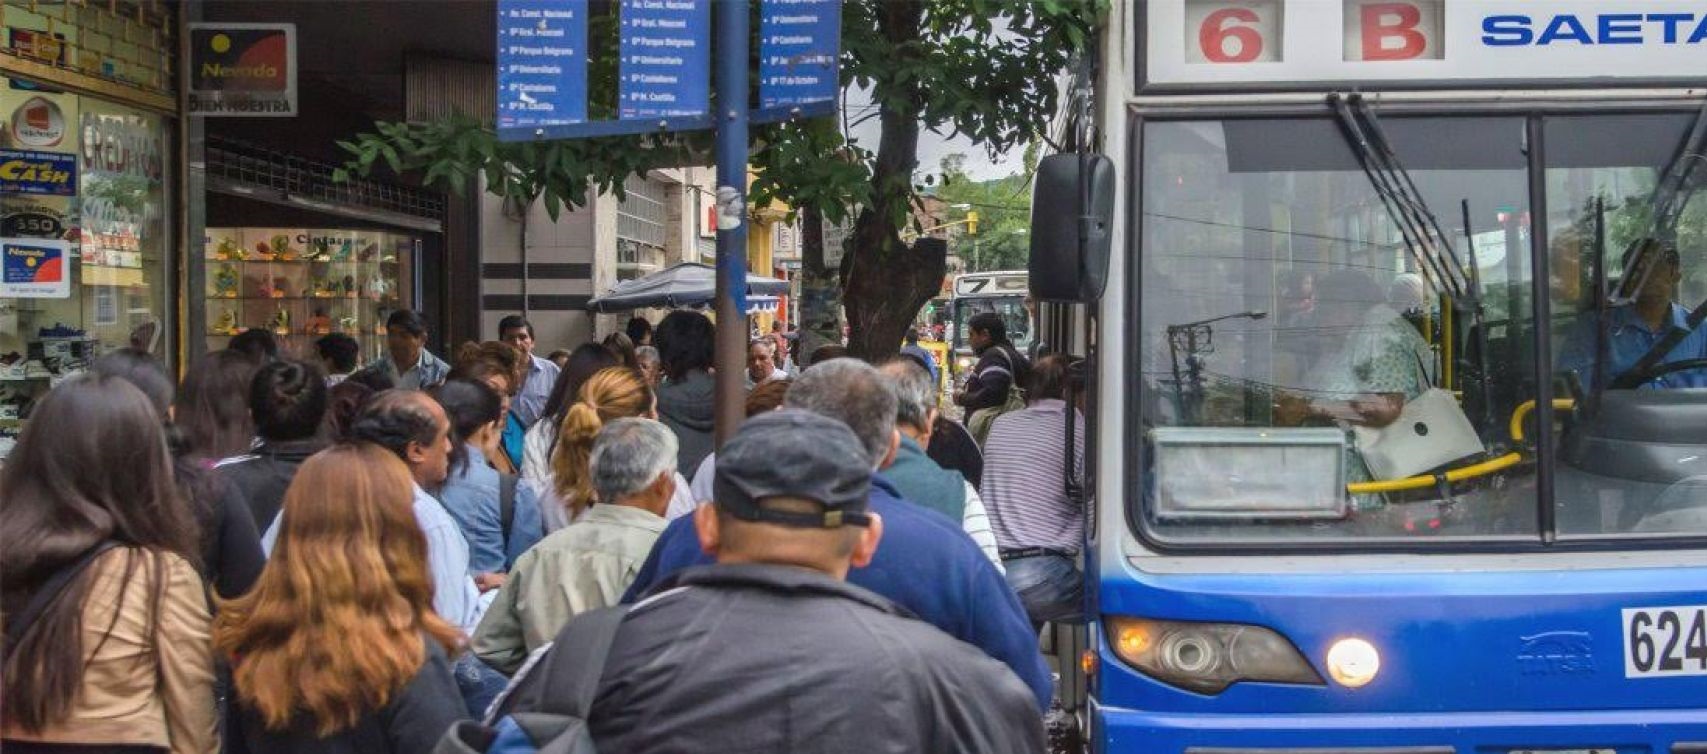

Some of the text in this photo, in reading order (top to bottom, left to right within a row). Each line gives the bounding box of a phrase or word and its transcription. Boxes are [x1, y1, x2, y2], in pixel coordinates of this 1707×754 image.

[1200, 8, 1263, 63] 6
[1361, 2, 1426, 61] B
[201, 62, 277, 78] Nevada
[0, 159, 69, 183] CASH
[963, 278, 991, 293] 7
